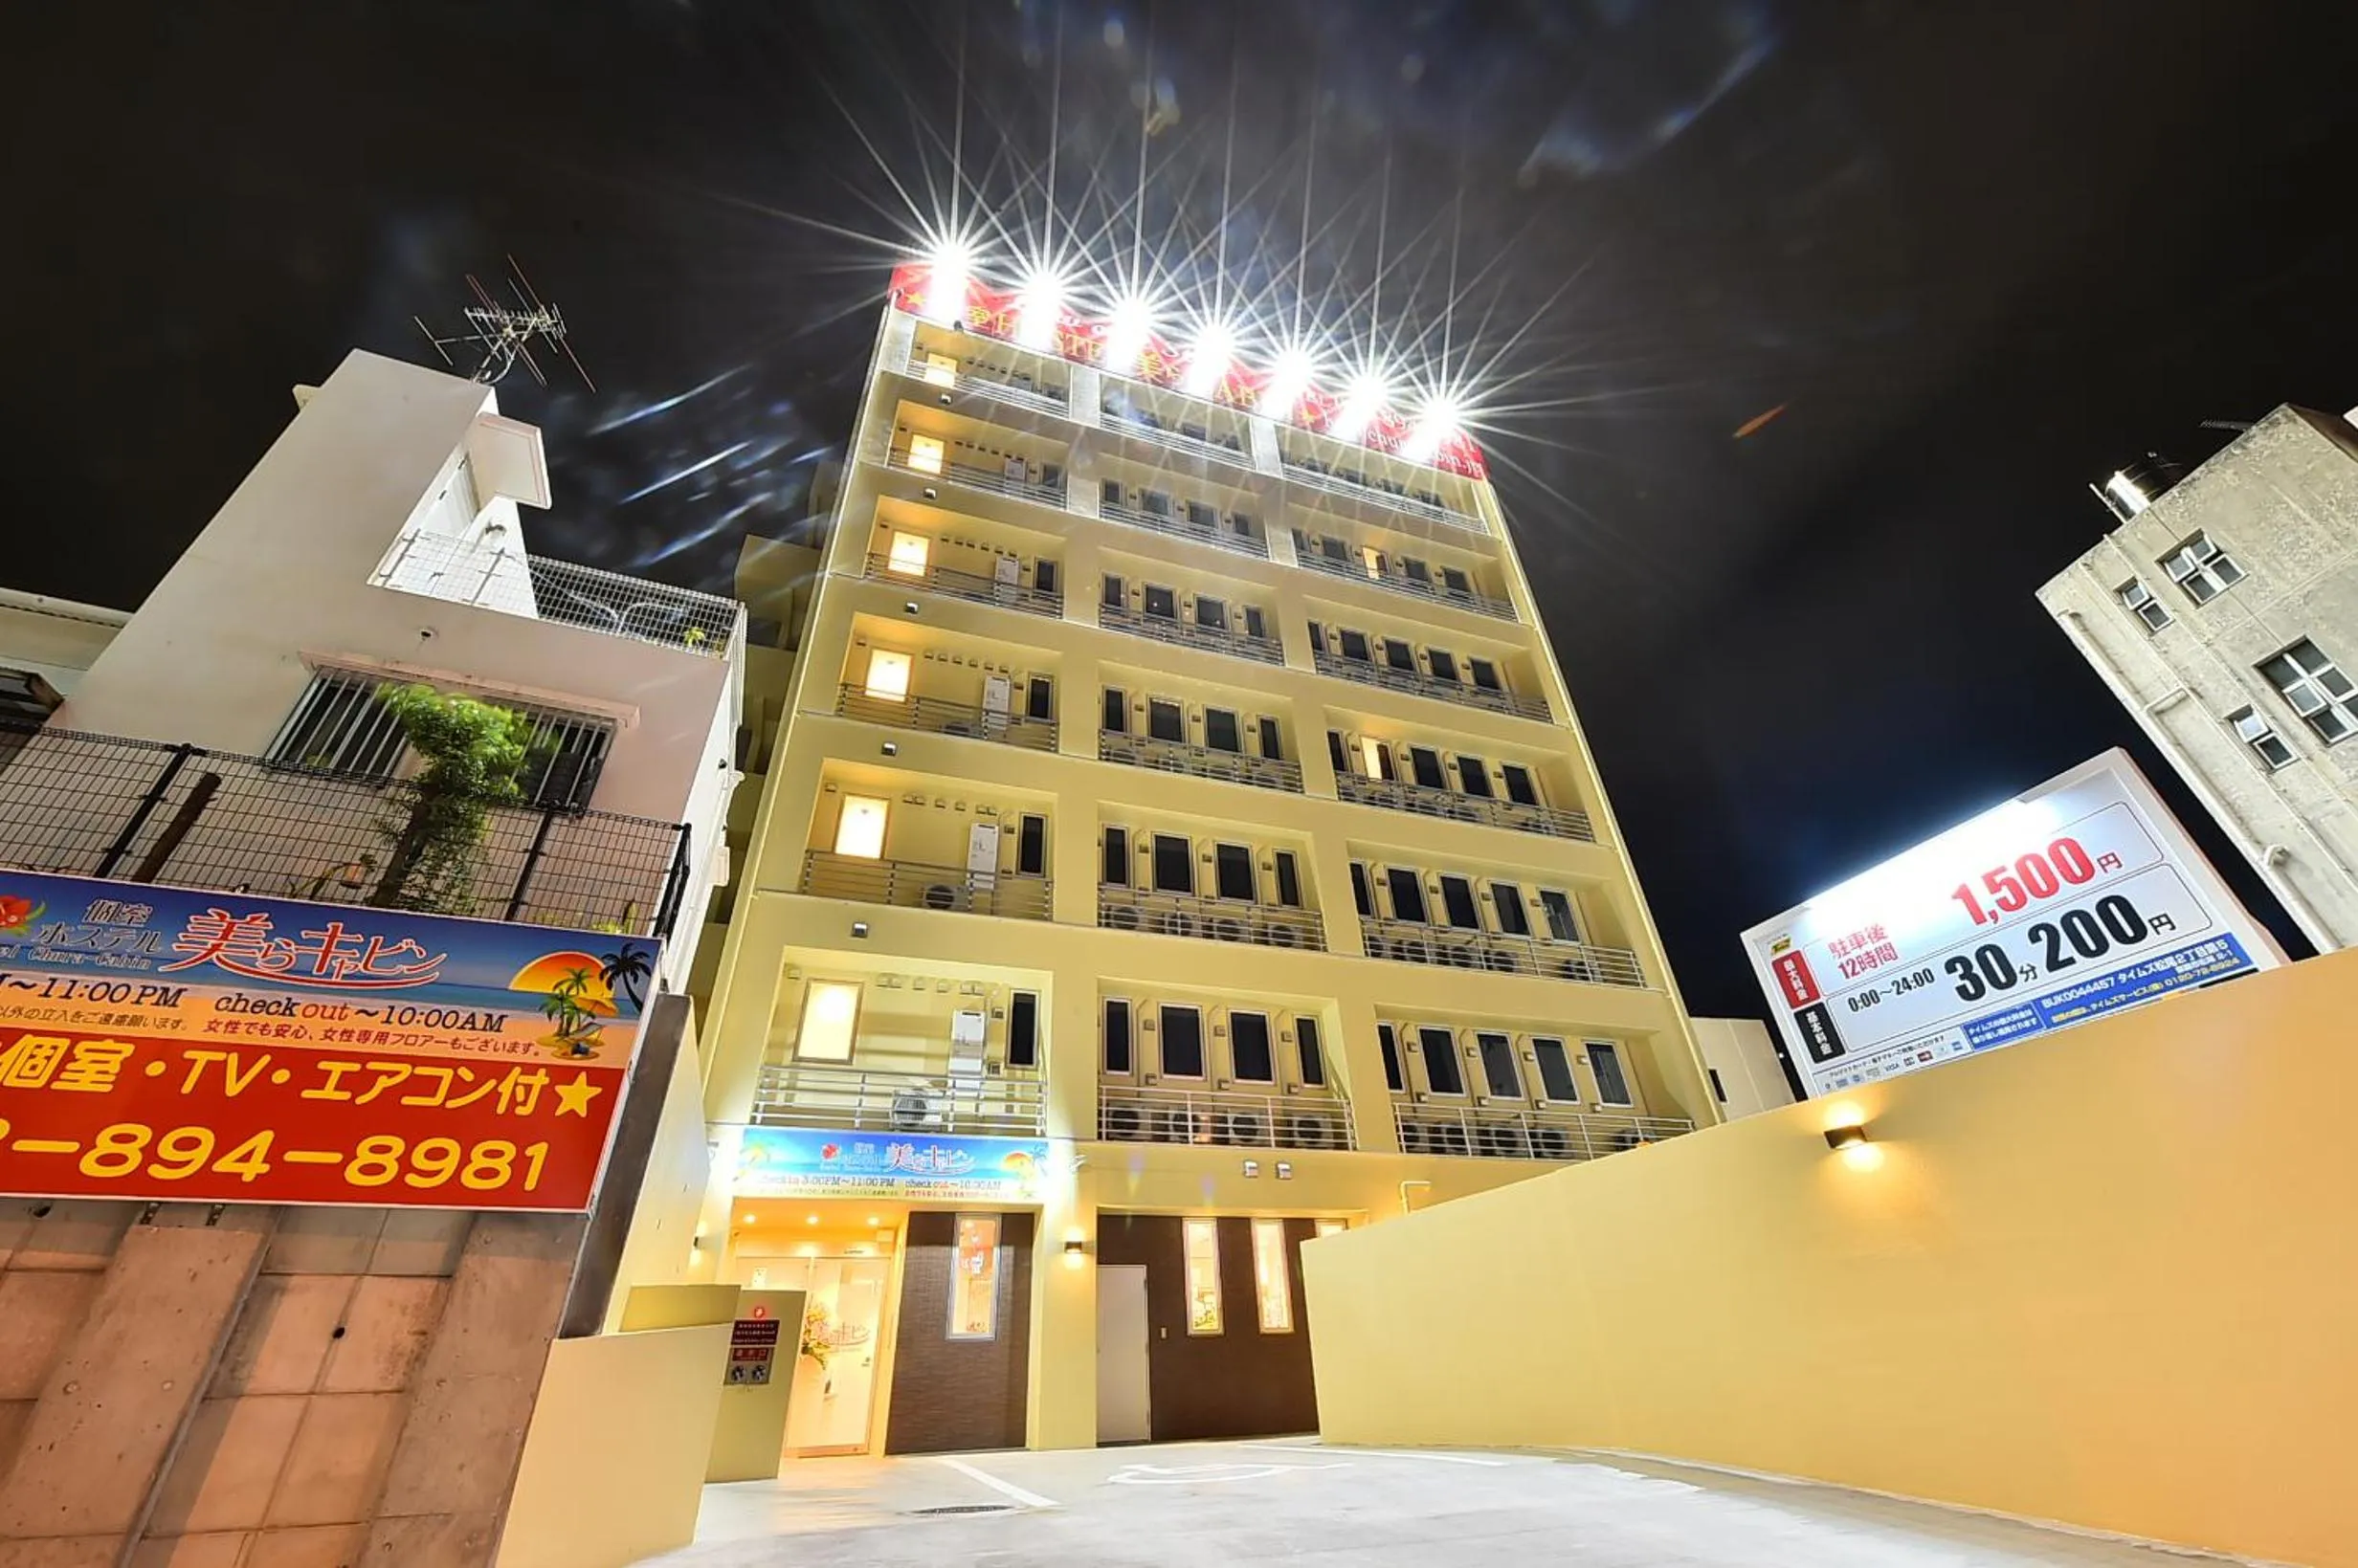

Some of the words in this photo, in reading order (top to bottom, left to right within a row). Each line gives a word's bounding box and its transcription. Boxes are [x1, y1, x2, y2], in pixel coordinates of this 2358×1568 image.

[82, 899, 153, 927] 個室
[33, 922, 161, 955] ホステル
[158, 909, 448, 988] 美らキャビン
[1828, 923, 1889, 959] 駐車後
[1837, 942, 1899, 980] 12時間
[214, 992, 301, 1018] check
[301, 1002, 350, 1022] out
